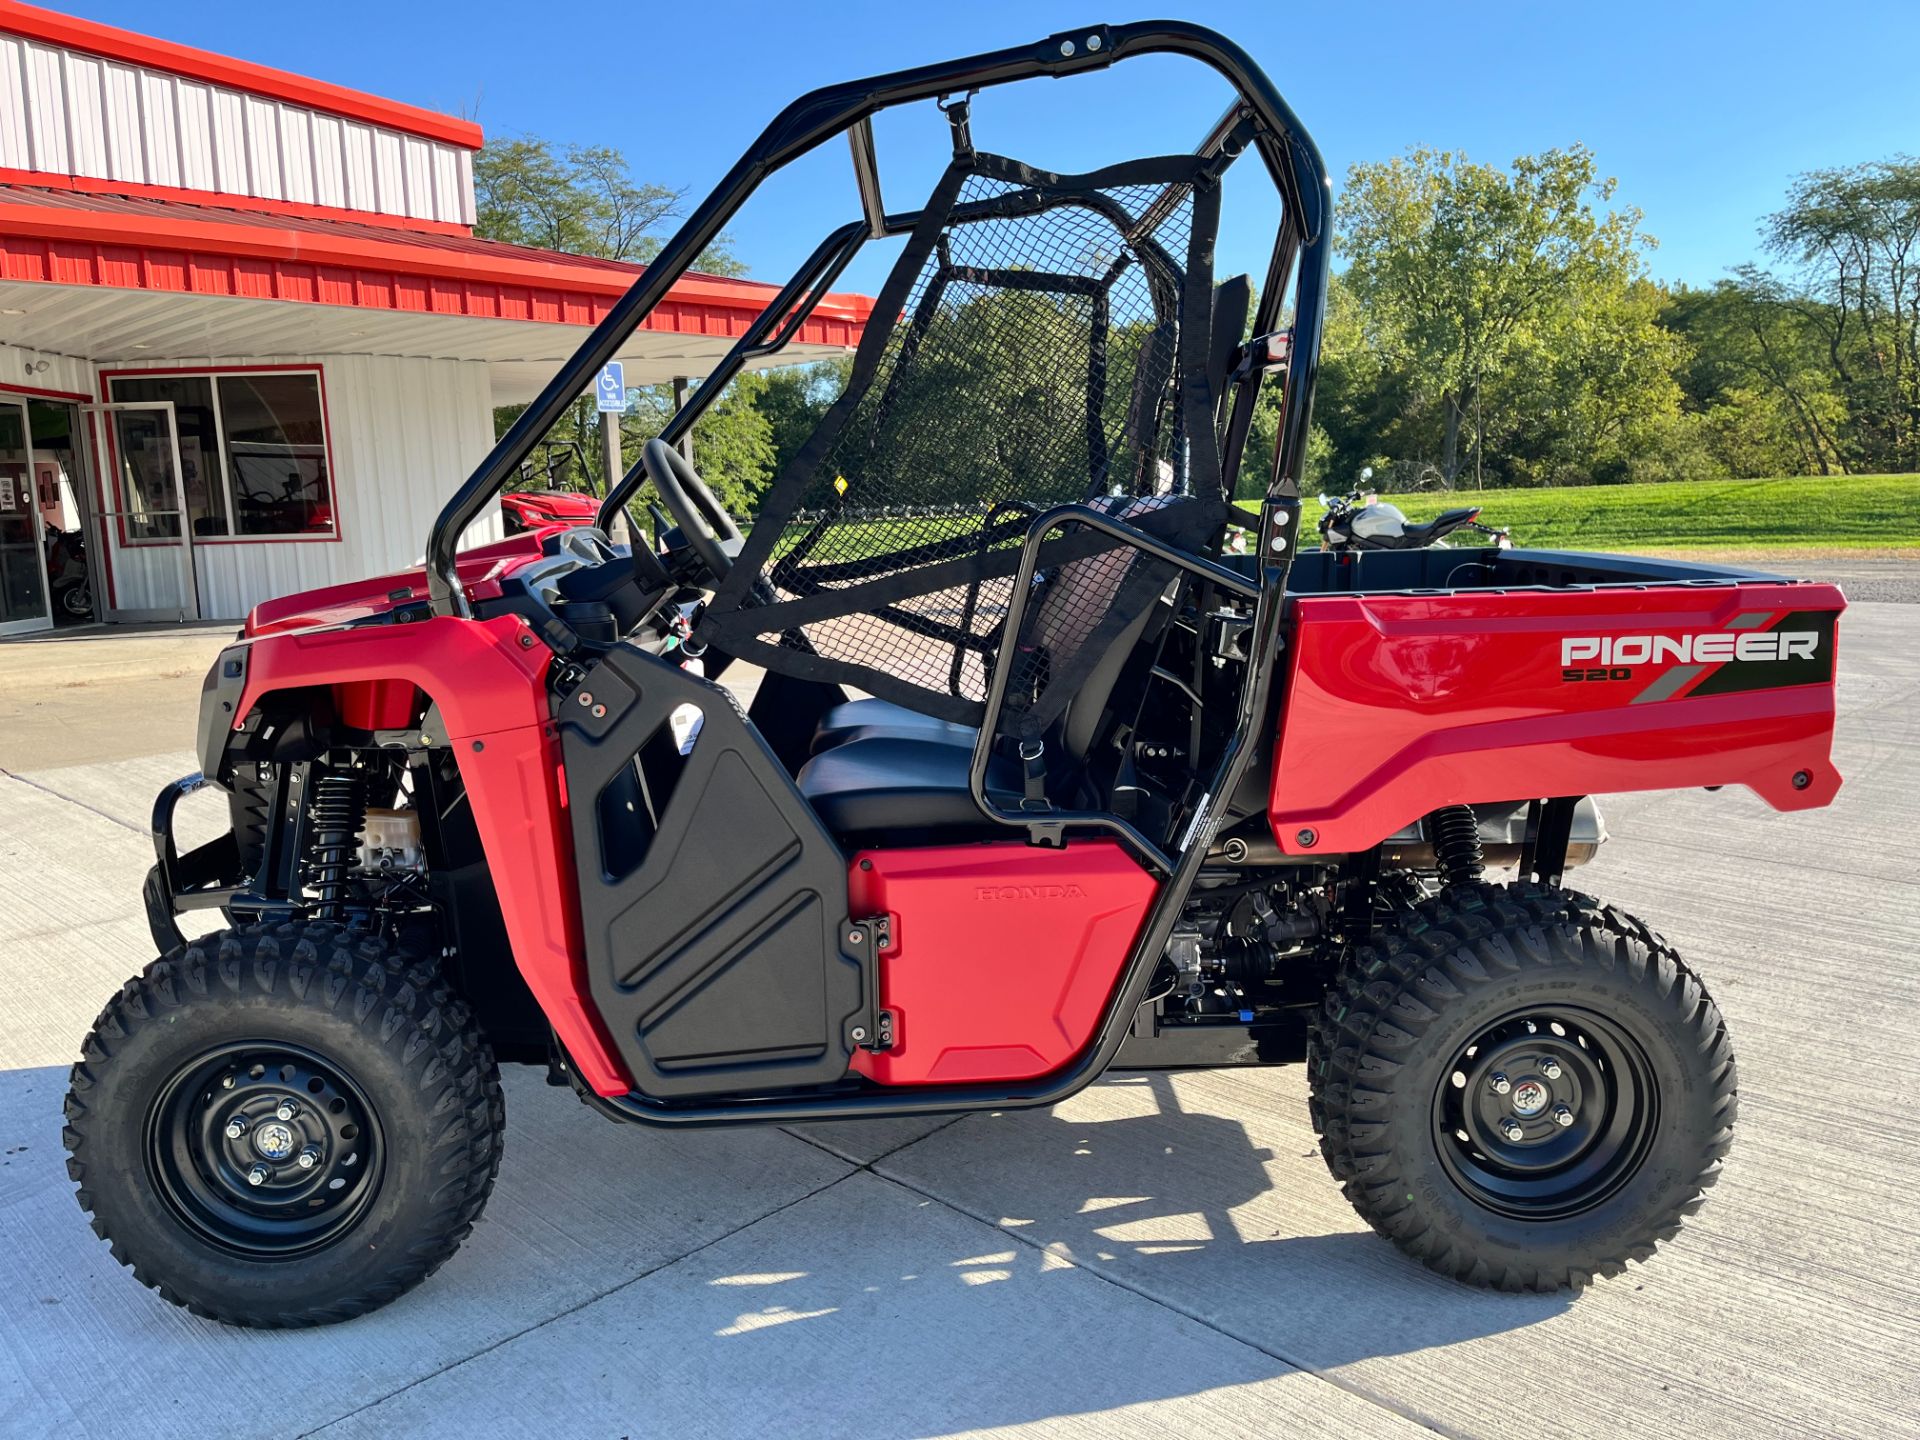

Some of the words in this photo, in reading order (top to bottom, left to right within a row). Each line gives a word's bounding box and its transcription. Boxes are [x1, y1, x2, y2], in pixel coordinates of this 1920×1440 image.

[1561, 631, 1819, 667] PIONEER
[1562, 668, 1632, 683] 520
[975, 884, 1088, 901] HONDA
